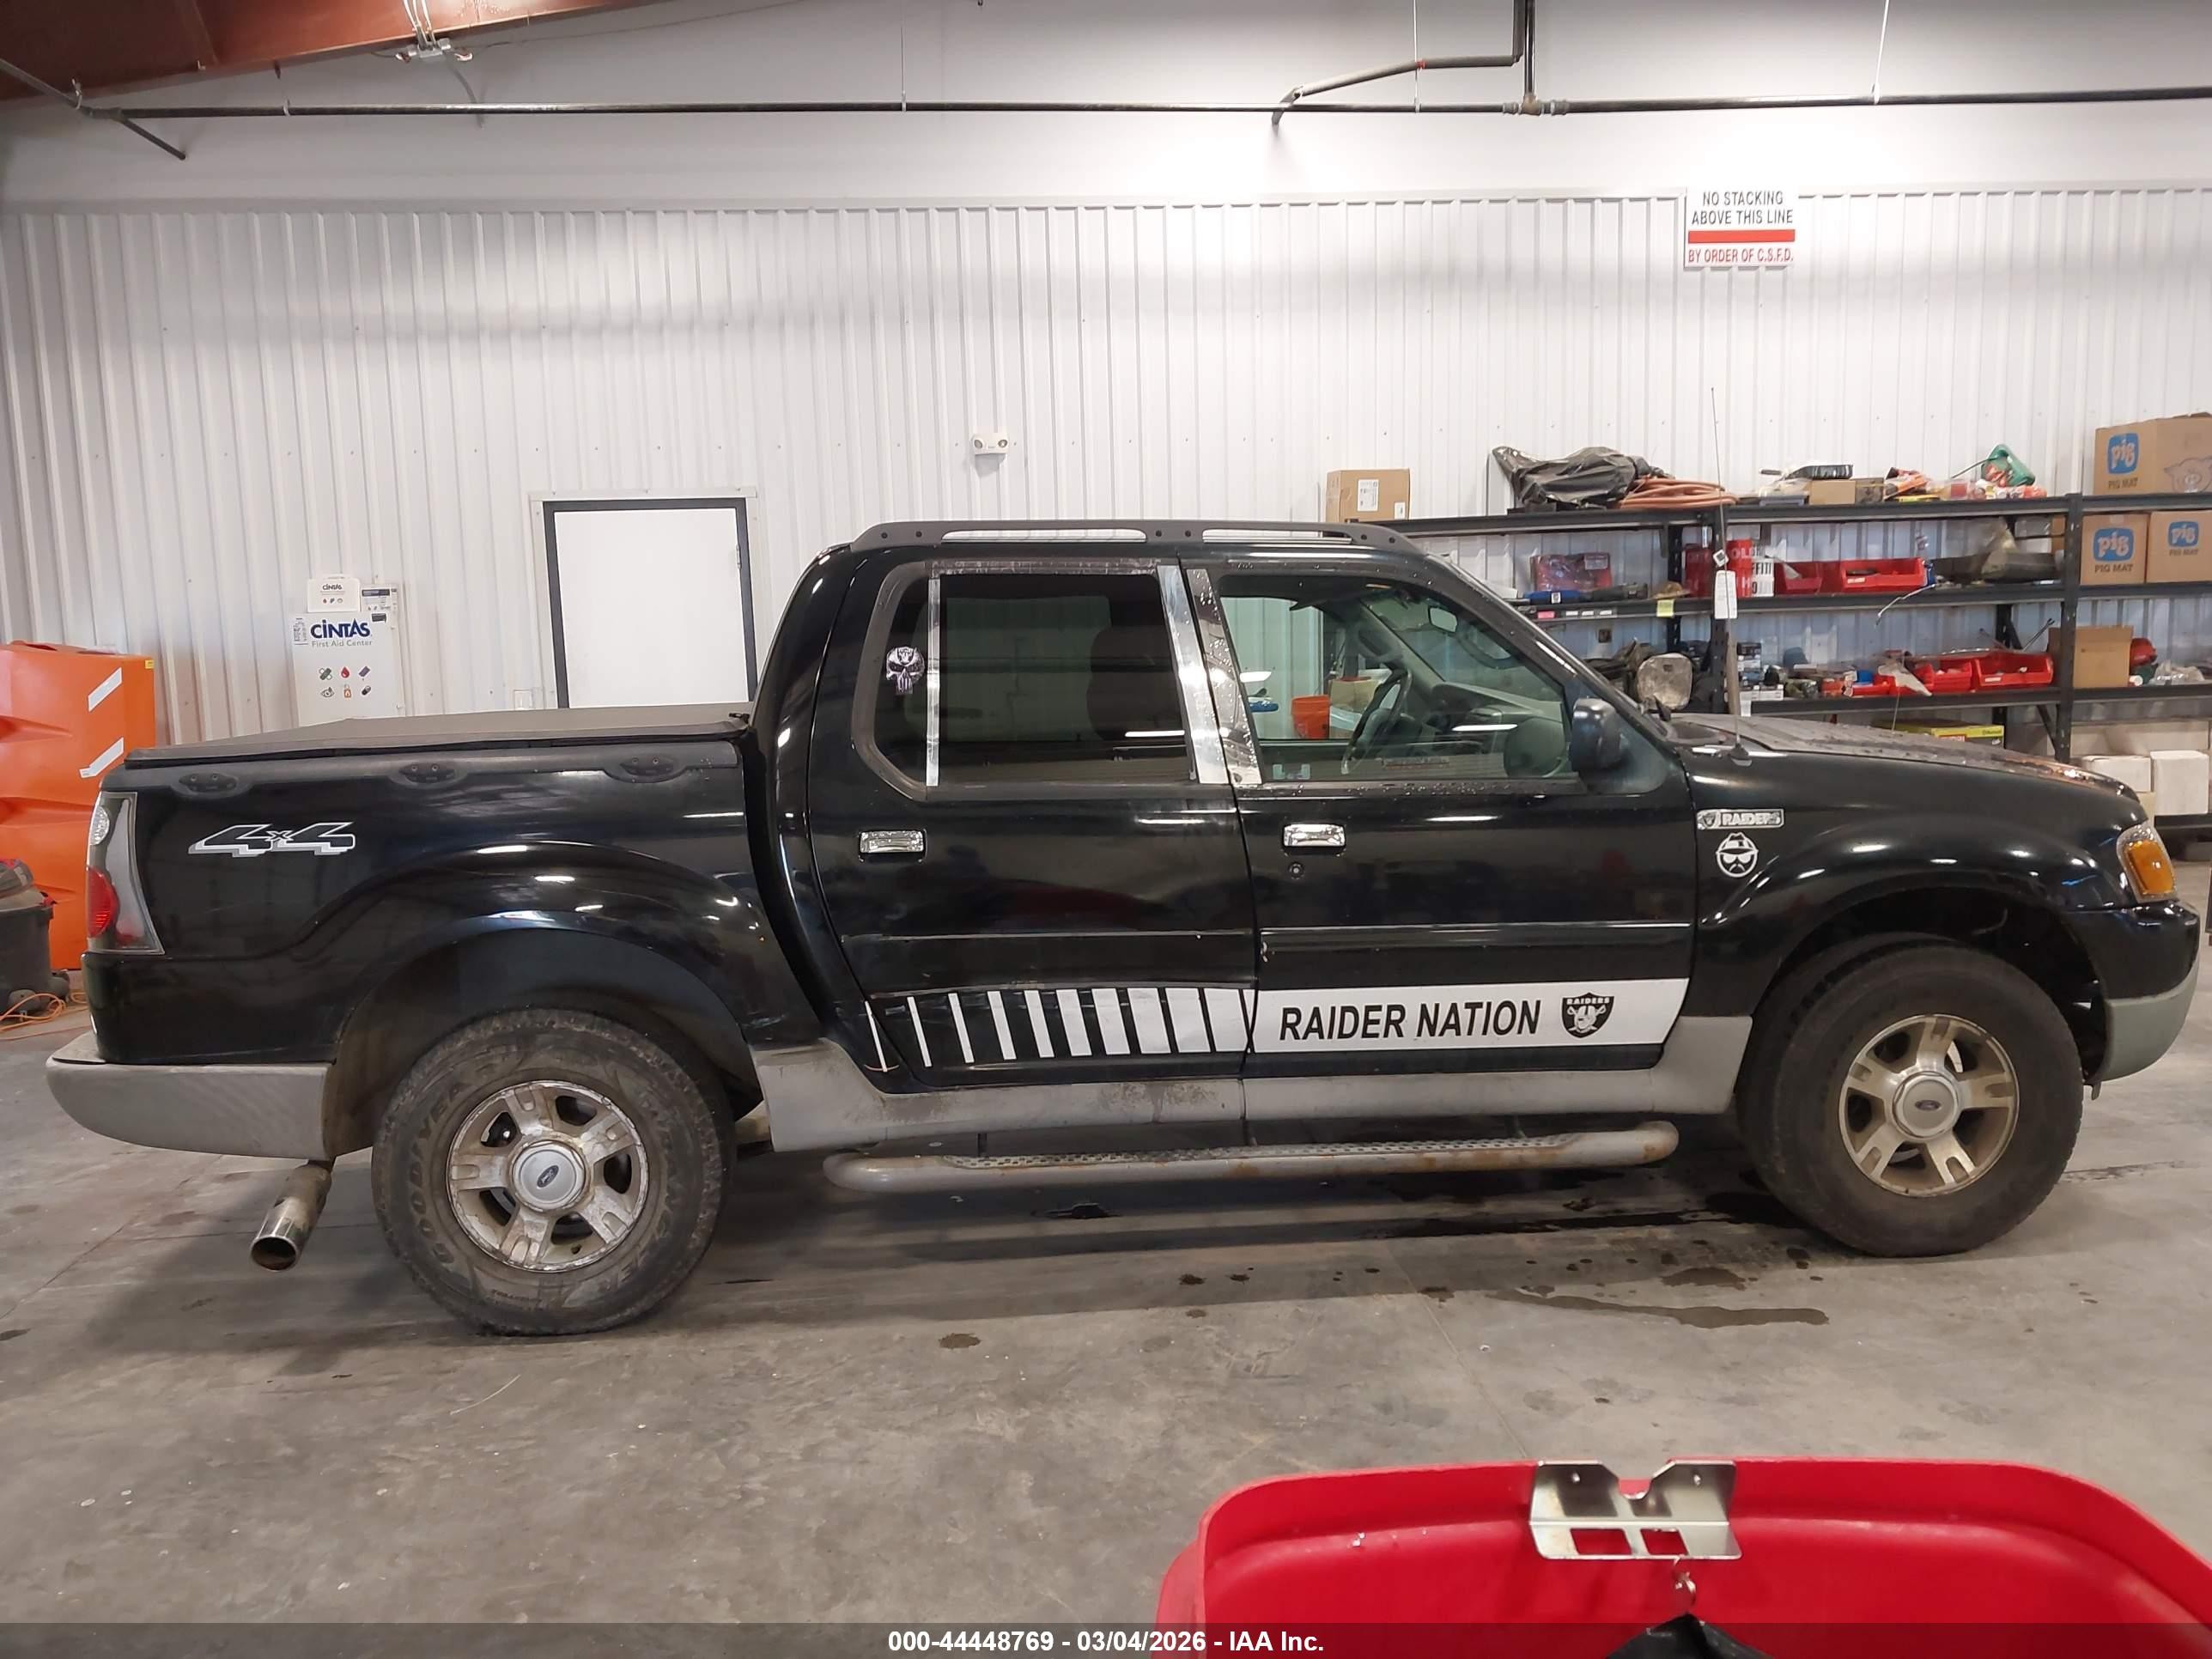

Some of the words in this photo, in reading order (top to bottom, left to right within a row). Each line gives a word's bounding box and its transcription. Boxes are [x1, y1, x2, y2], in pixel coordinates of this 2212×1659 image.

[1703, 191, 1719, 206] NO
[1723, 190, 1784, 206] STACKING
[1692, 210, 1732, 225] ABOVE
[1735, 210, 1763, 225] THIS
[1767, 210, 1793, 224] LINE
[1688, 249, 1701, 263] BY
[1705, 248, 1738, 263] ORDER
[1741, 248, 1754, 262] OF
[2108, 479, 2121, 490] PIG
[2122, 477, 2138, 489] MAT
[2094, 564, 2111, 573] PIG
[2112, 563, 2133, 573] MAT
[1566, 997, 1610, 1006] RAIDERS
[1279, 1002, 1407, 1042] RAIDER
[1417, 1000, 1541, 1038] NATION
